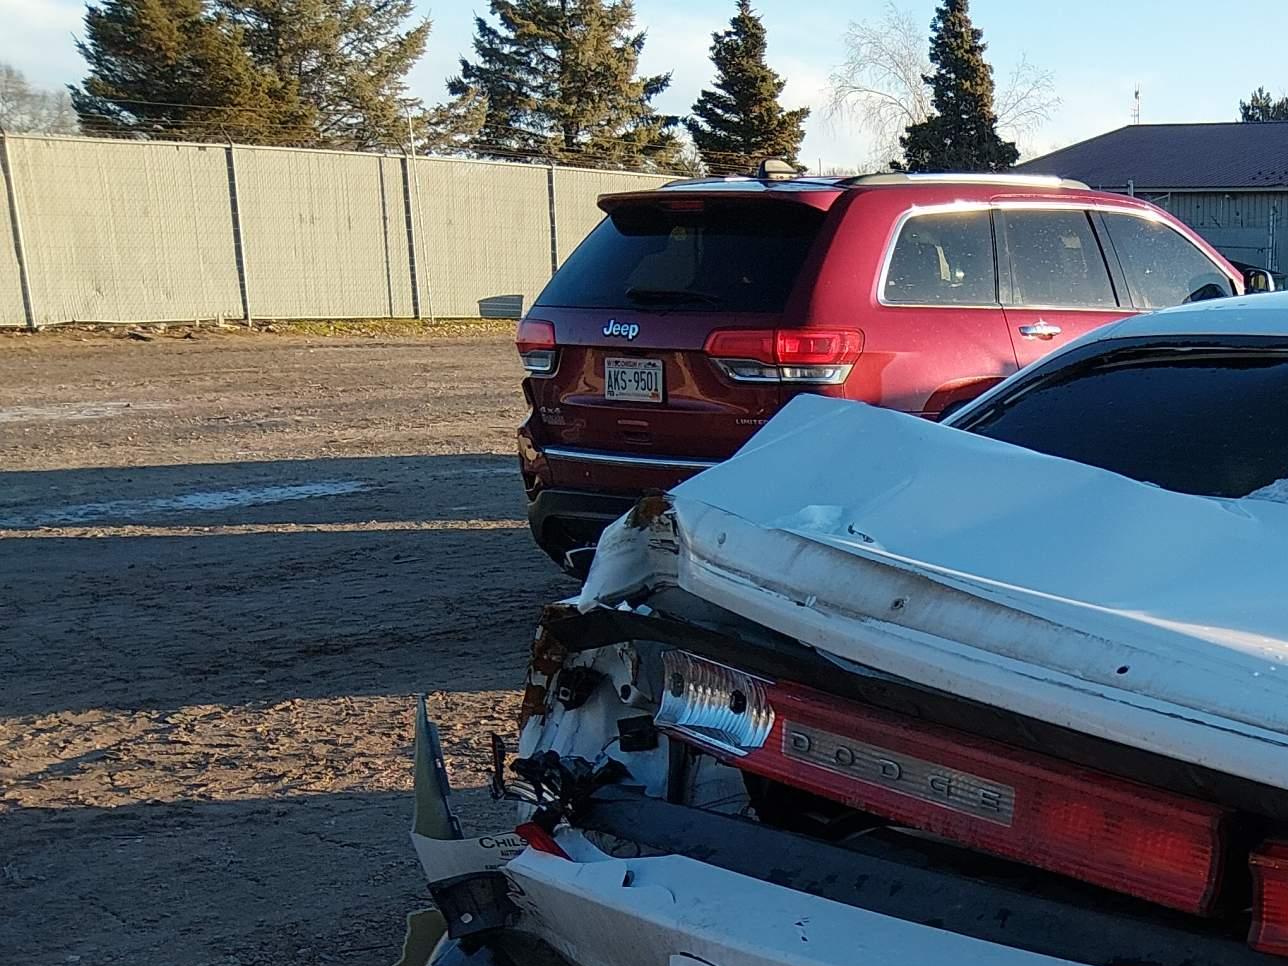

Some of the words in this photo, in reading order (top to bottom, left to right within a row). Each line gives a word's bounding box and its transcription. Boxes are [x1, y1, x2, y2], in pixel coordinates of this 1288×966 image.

[603, 319, 639, 340] Jeep
[607, 370, 659, 392] AKS-9501
[790, 730, 1001, 812] DODGE
